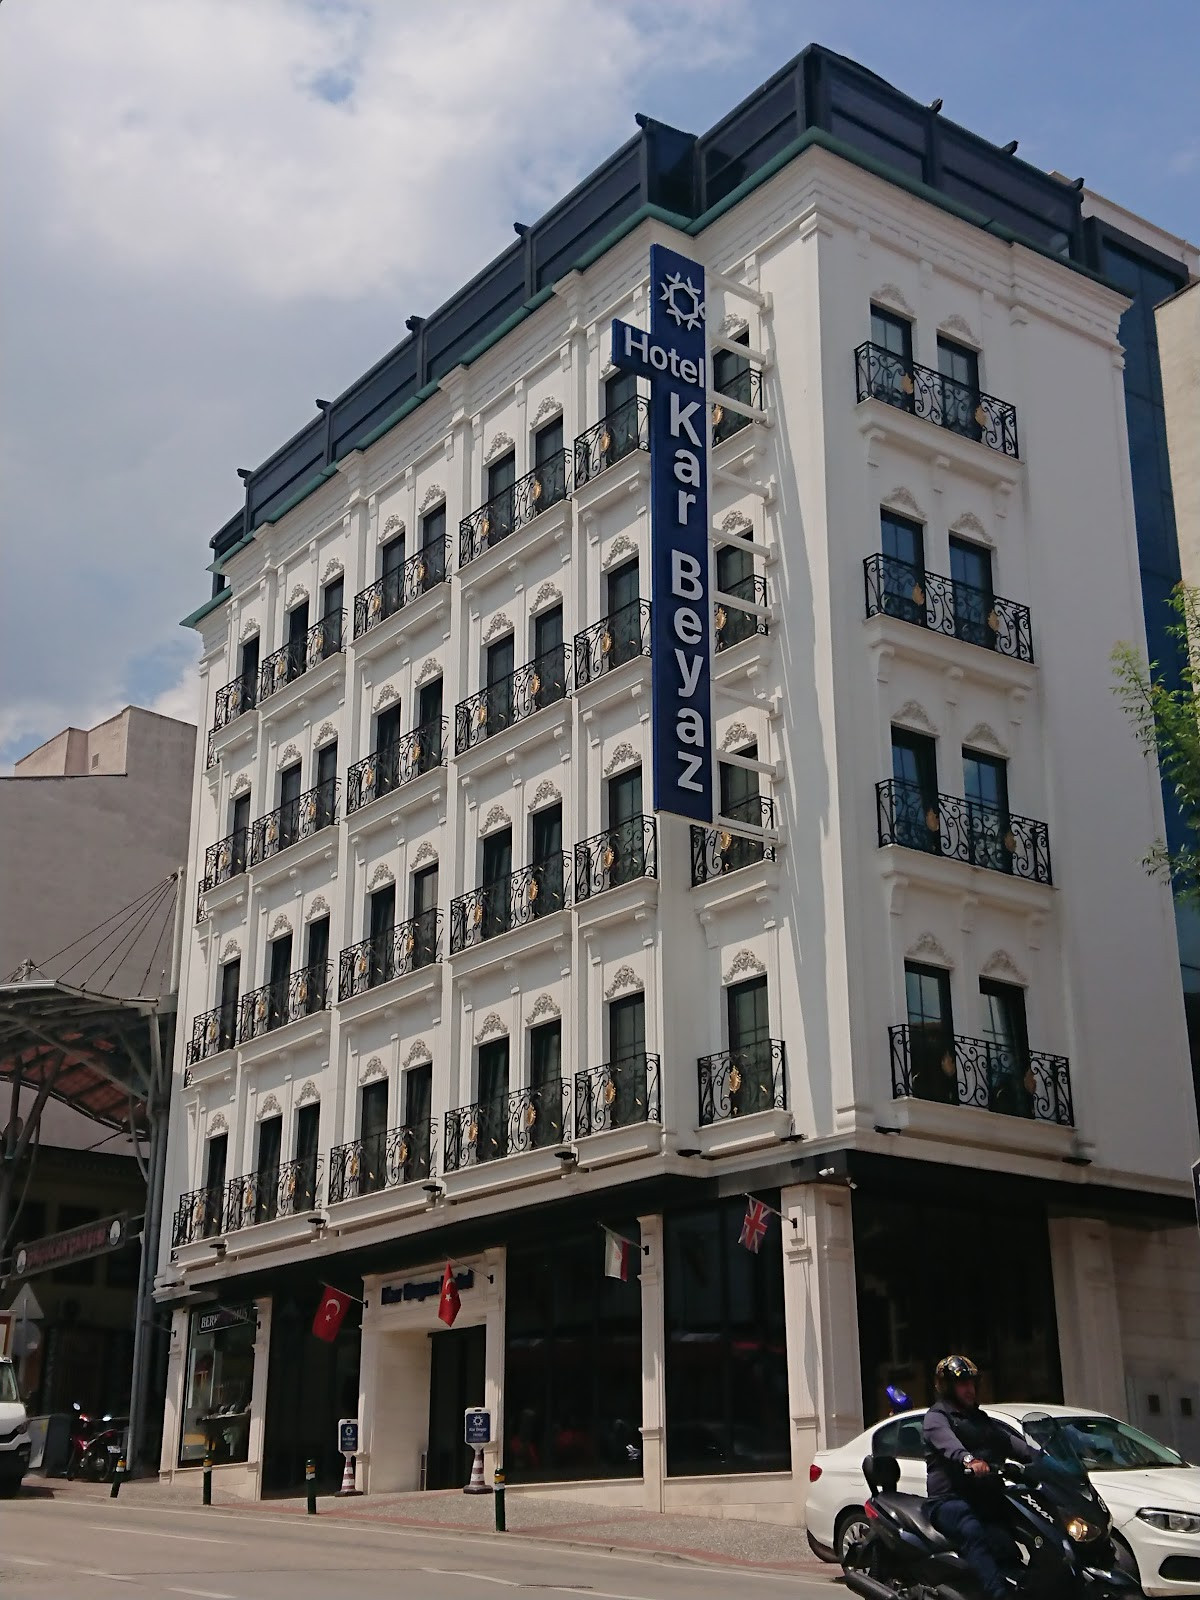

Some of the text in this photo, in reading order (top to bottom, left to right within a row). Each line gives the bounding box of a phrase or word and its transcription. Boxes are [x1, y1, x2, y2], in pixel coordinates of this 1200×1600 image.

[625, 326, 704, 388] Hotel
[670, 391, 704, 793] Kar Beyaz
